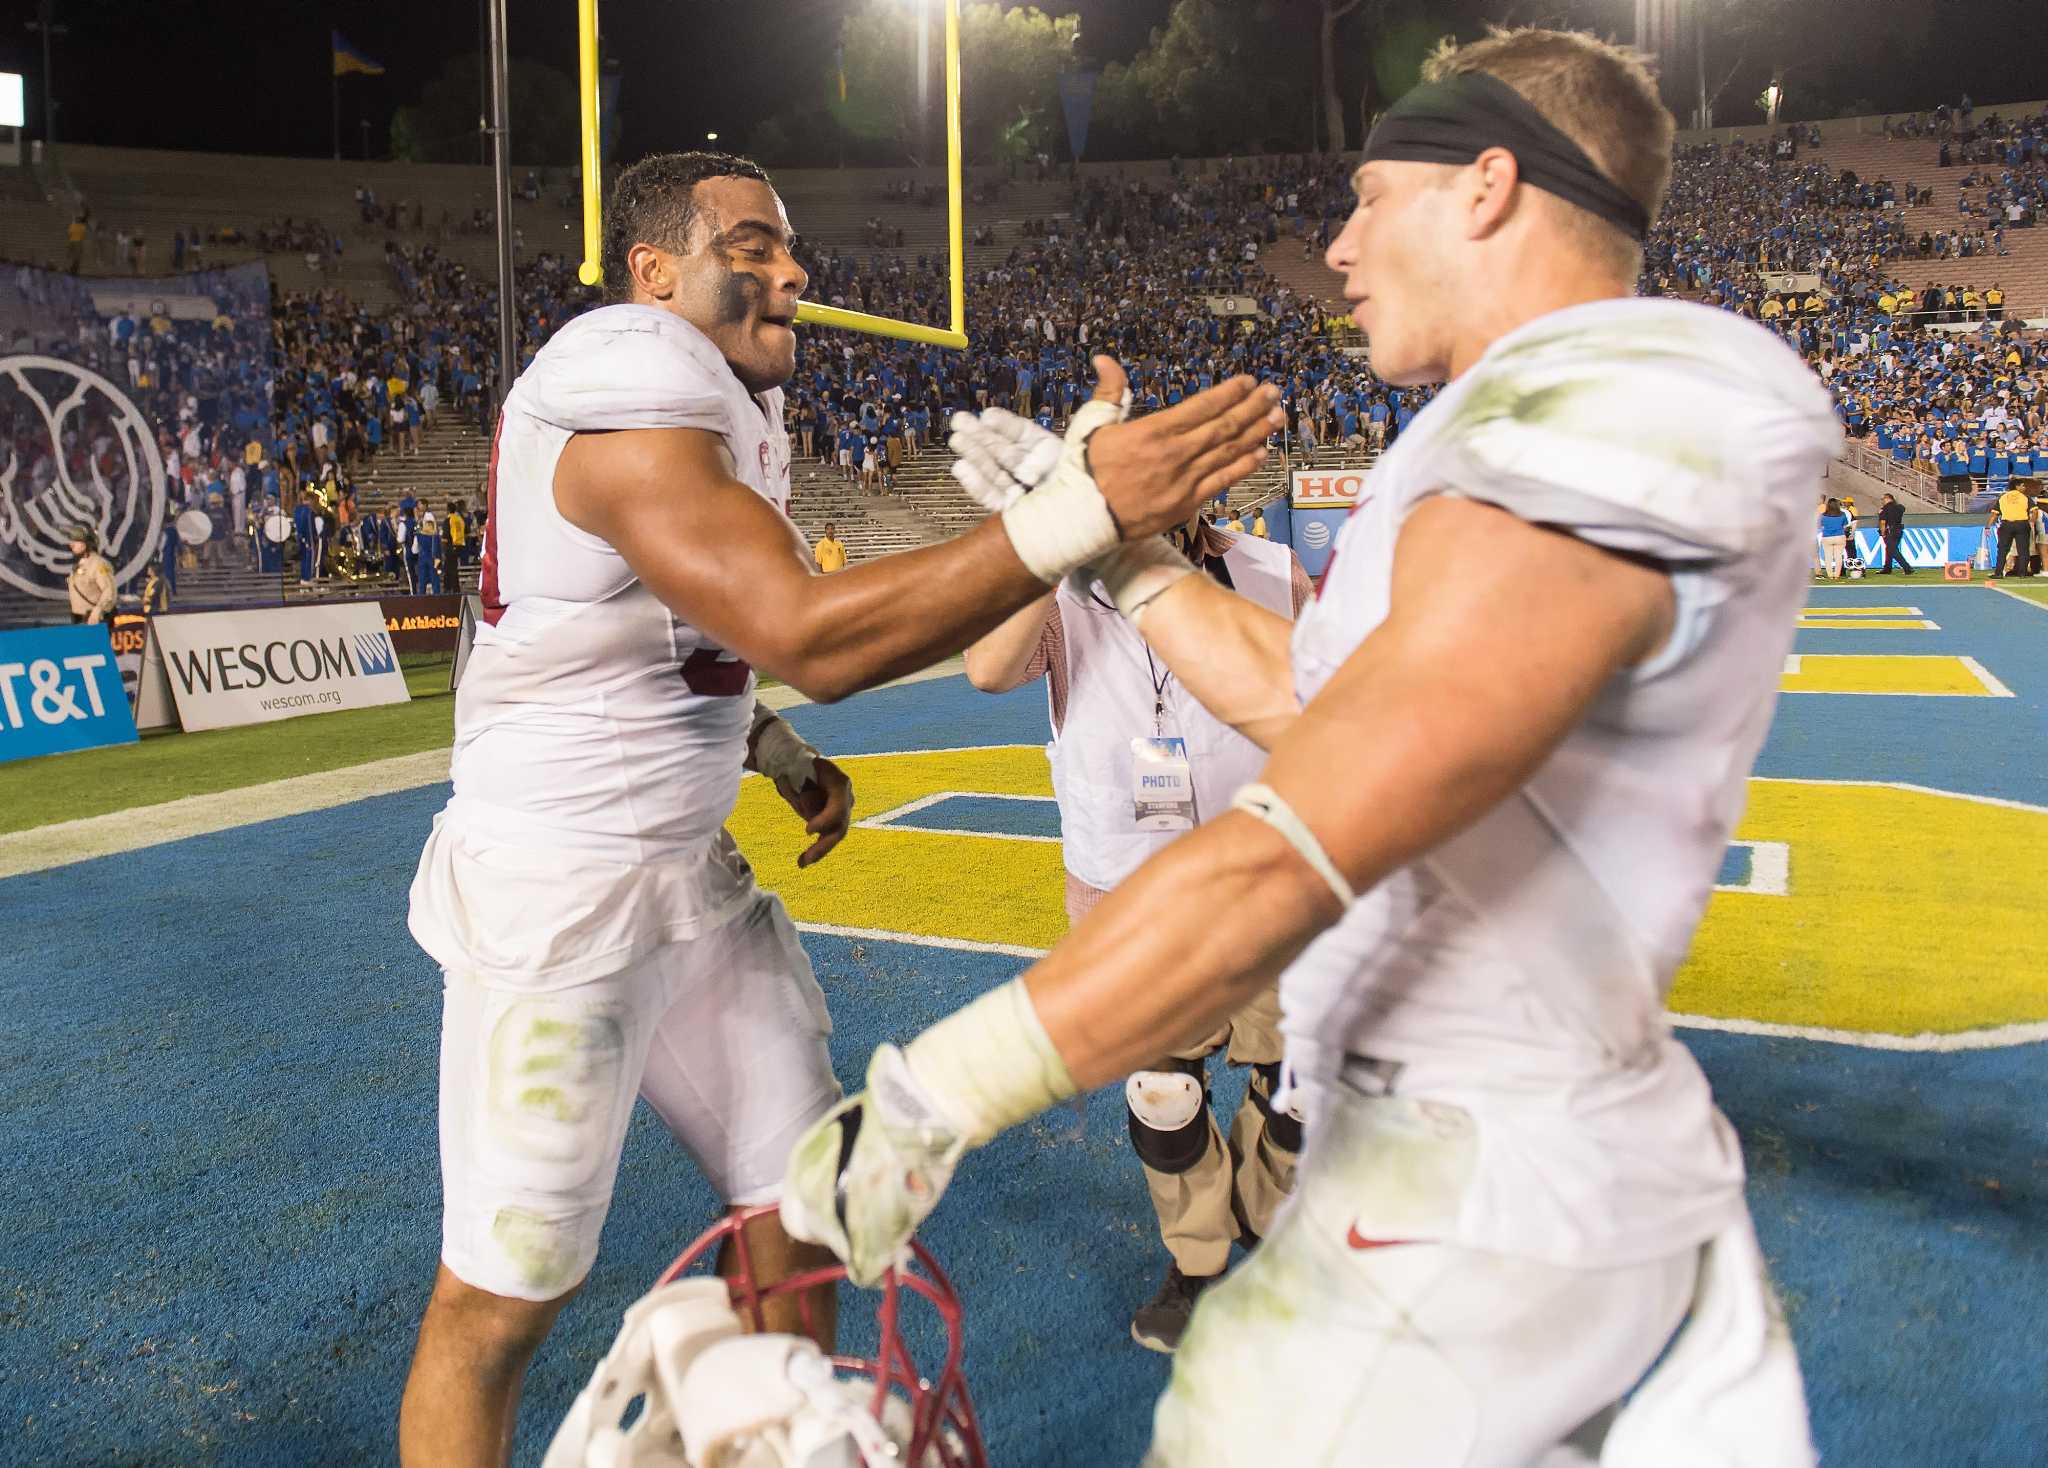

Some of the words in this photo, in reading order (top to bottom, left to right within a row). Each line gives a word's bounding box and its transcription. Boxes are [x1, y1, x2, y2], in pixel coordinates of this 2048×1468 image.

[1786, 278, 1794, 288] 7
[1949, 564, 1967, 578] G
[401, 614, 460, 630] Athletics
[111, 630, 145, 656] ups
[170, 637, 357, 696] WESCOM
[0, 654, 107, 732] T&T
[260, 690, 342, 712] wescom.org
[1142, 775, 1181, 788] PHOTO
